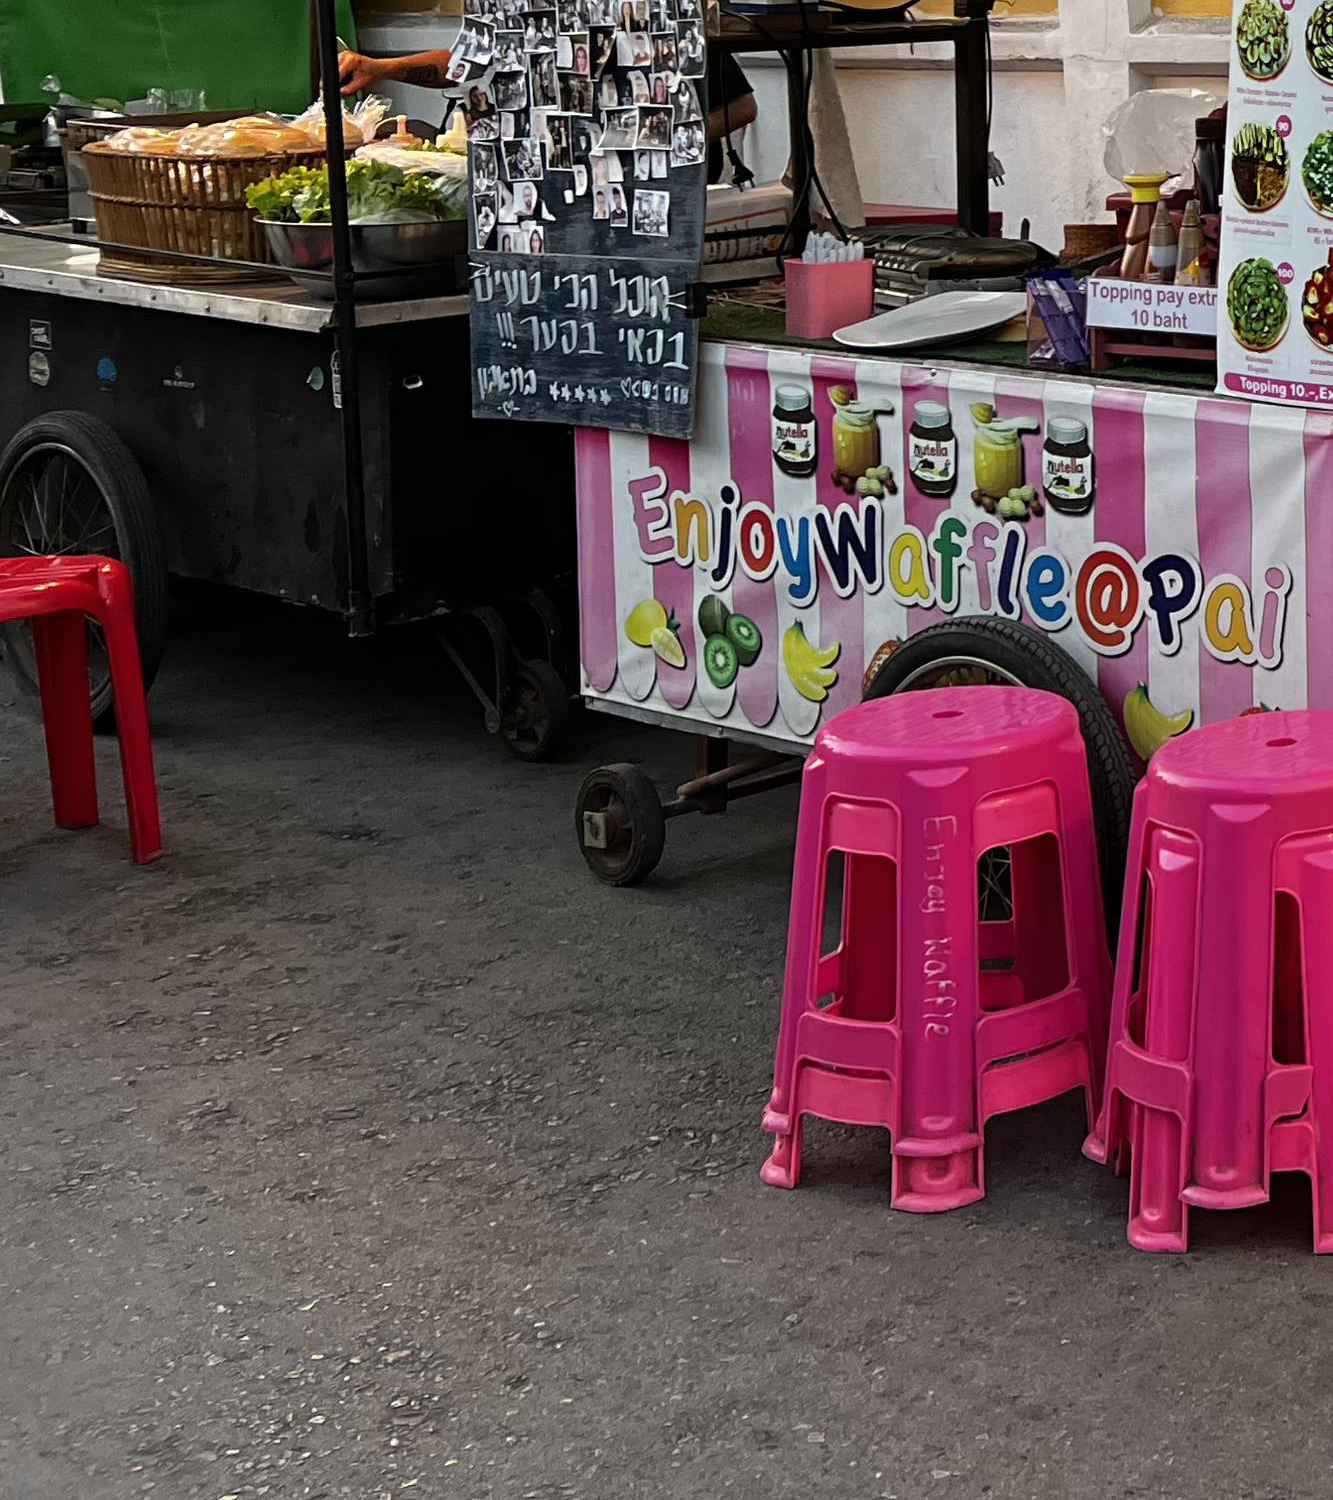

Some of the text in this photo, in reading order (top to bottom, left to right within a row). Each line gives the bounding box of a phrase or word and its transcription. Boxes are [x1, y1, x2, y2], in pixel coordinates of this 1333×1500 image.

[554, 274, 598, 311] הכי
[1090, 281, 1217, 307] Topping pay extr
[1131, 309, 1188, 330] 10 baht
[1240, 376, 1287, 398] Topping
[776, 422, 808, 440] nutella
[913, 441, 949, 458] nutella
[1046, 457, 1084, 476] nutella
